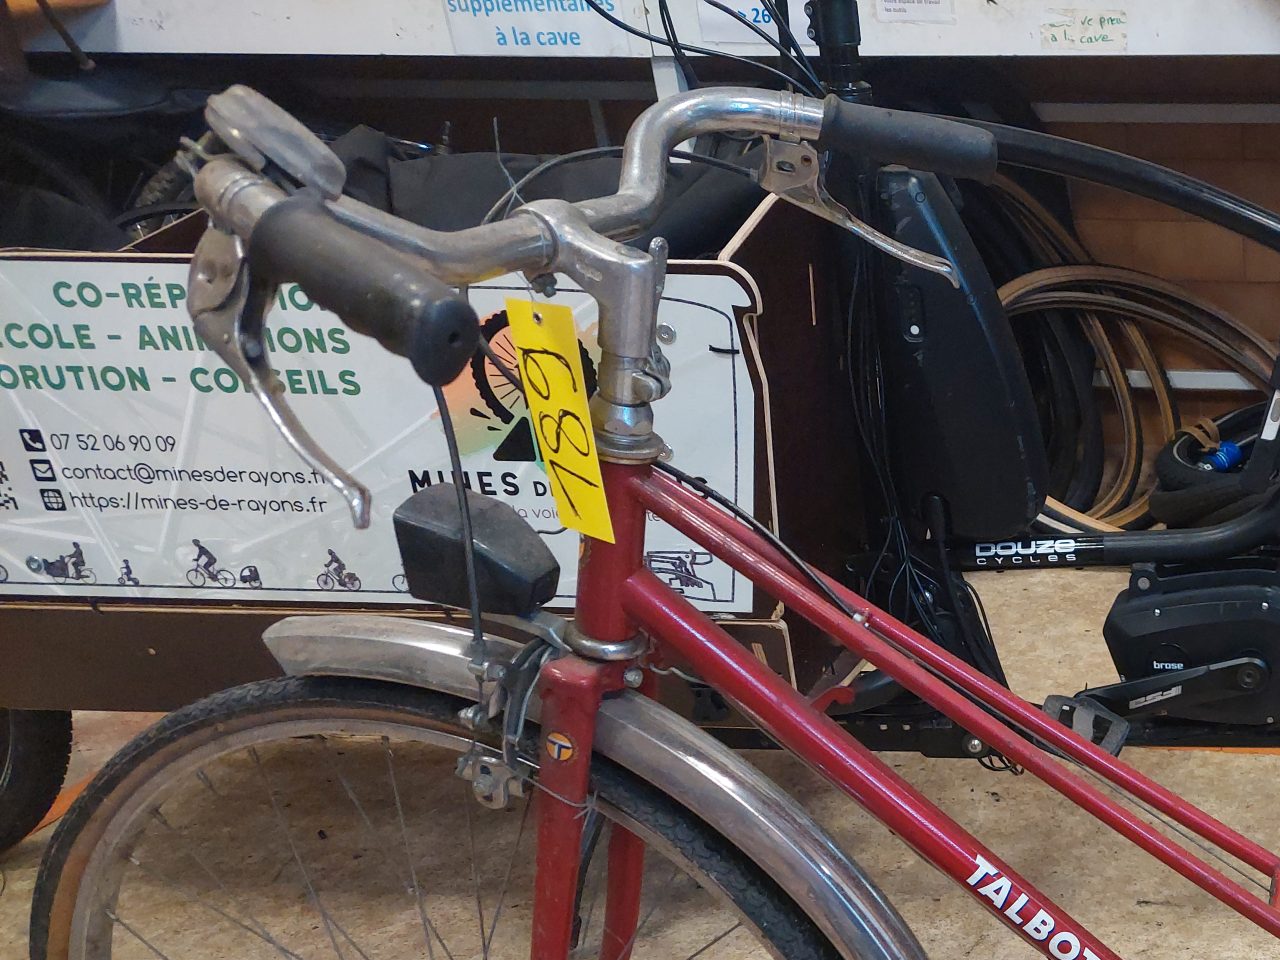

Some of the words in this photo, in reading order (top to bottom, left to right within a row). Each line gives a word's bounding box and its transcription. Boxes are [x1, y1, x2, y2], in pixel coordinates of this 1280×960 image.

[449, 0, 615, 17] supplémentais
[496, 26, 508, 46] à
[512, 26, 531, 46] la
[536, 31, 581, 46] cave
[1080, 34, 1114, 44] cave
[52, 276, 328, 312] CO-RÉPIO
[0, 322, 96, 349] COLE
[138, 324, 351, 355] ANIIONS
[190, 367, 361, 396] COEILS
[50, 433, 69, 450] 07
[76, 434, 100, 451] 52
[103, 434, 125, 451] 06
[129, 435, 151, 452] 90
[155, 435, 176, 452] 09
[533, 480, 554, 497] D
[69, 491, 328, 515] https://mines-de-rayons.fr
[532, 505, 560, 519] voi
[1153, 660, 1184, 670] brose
